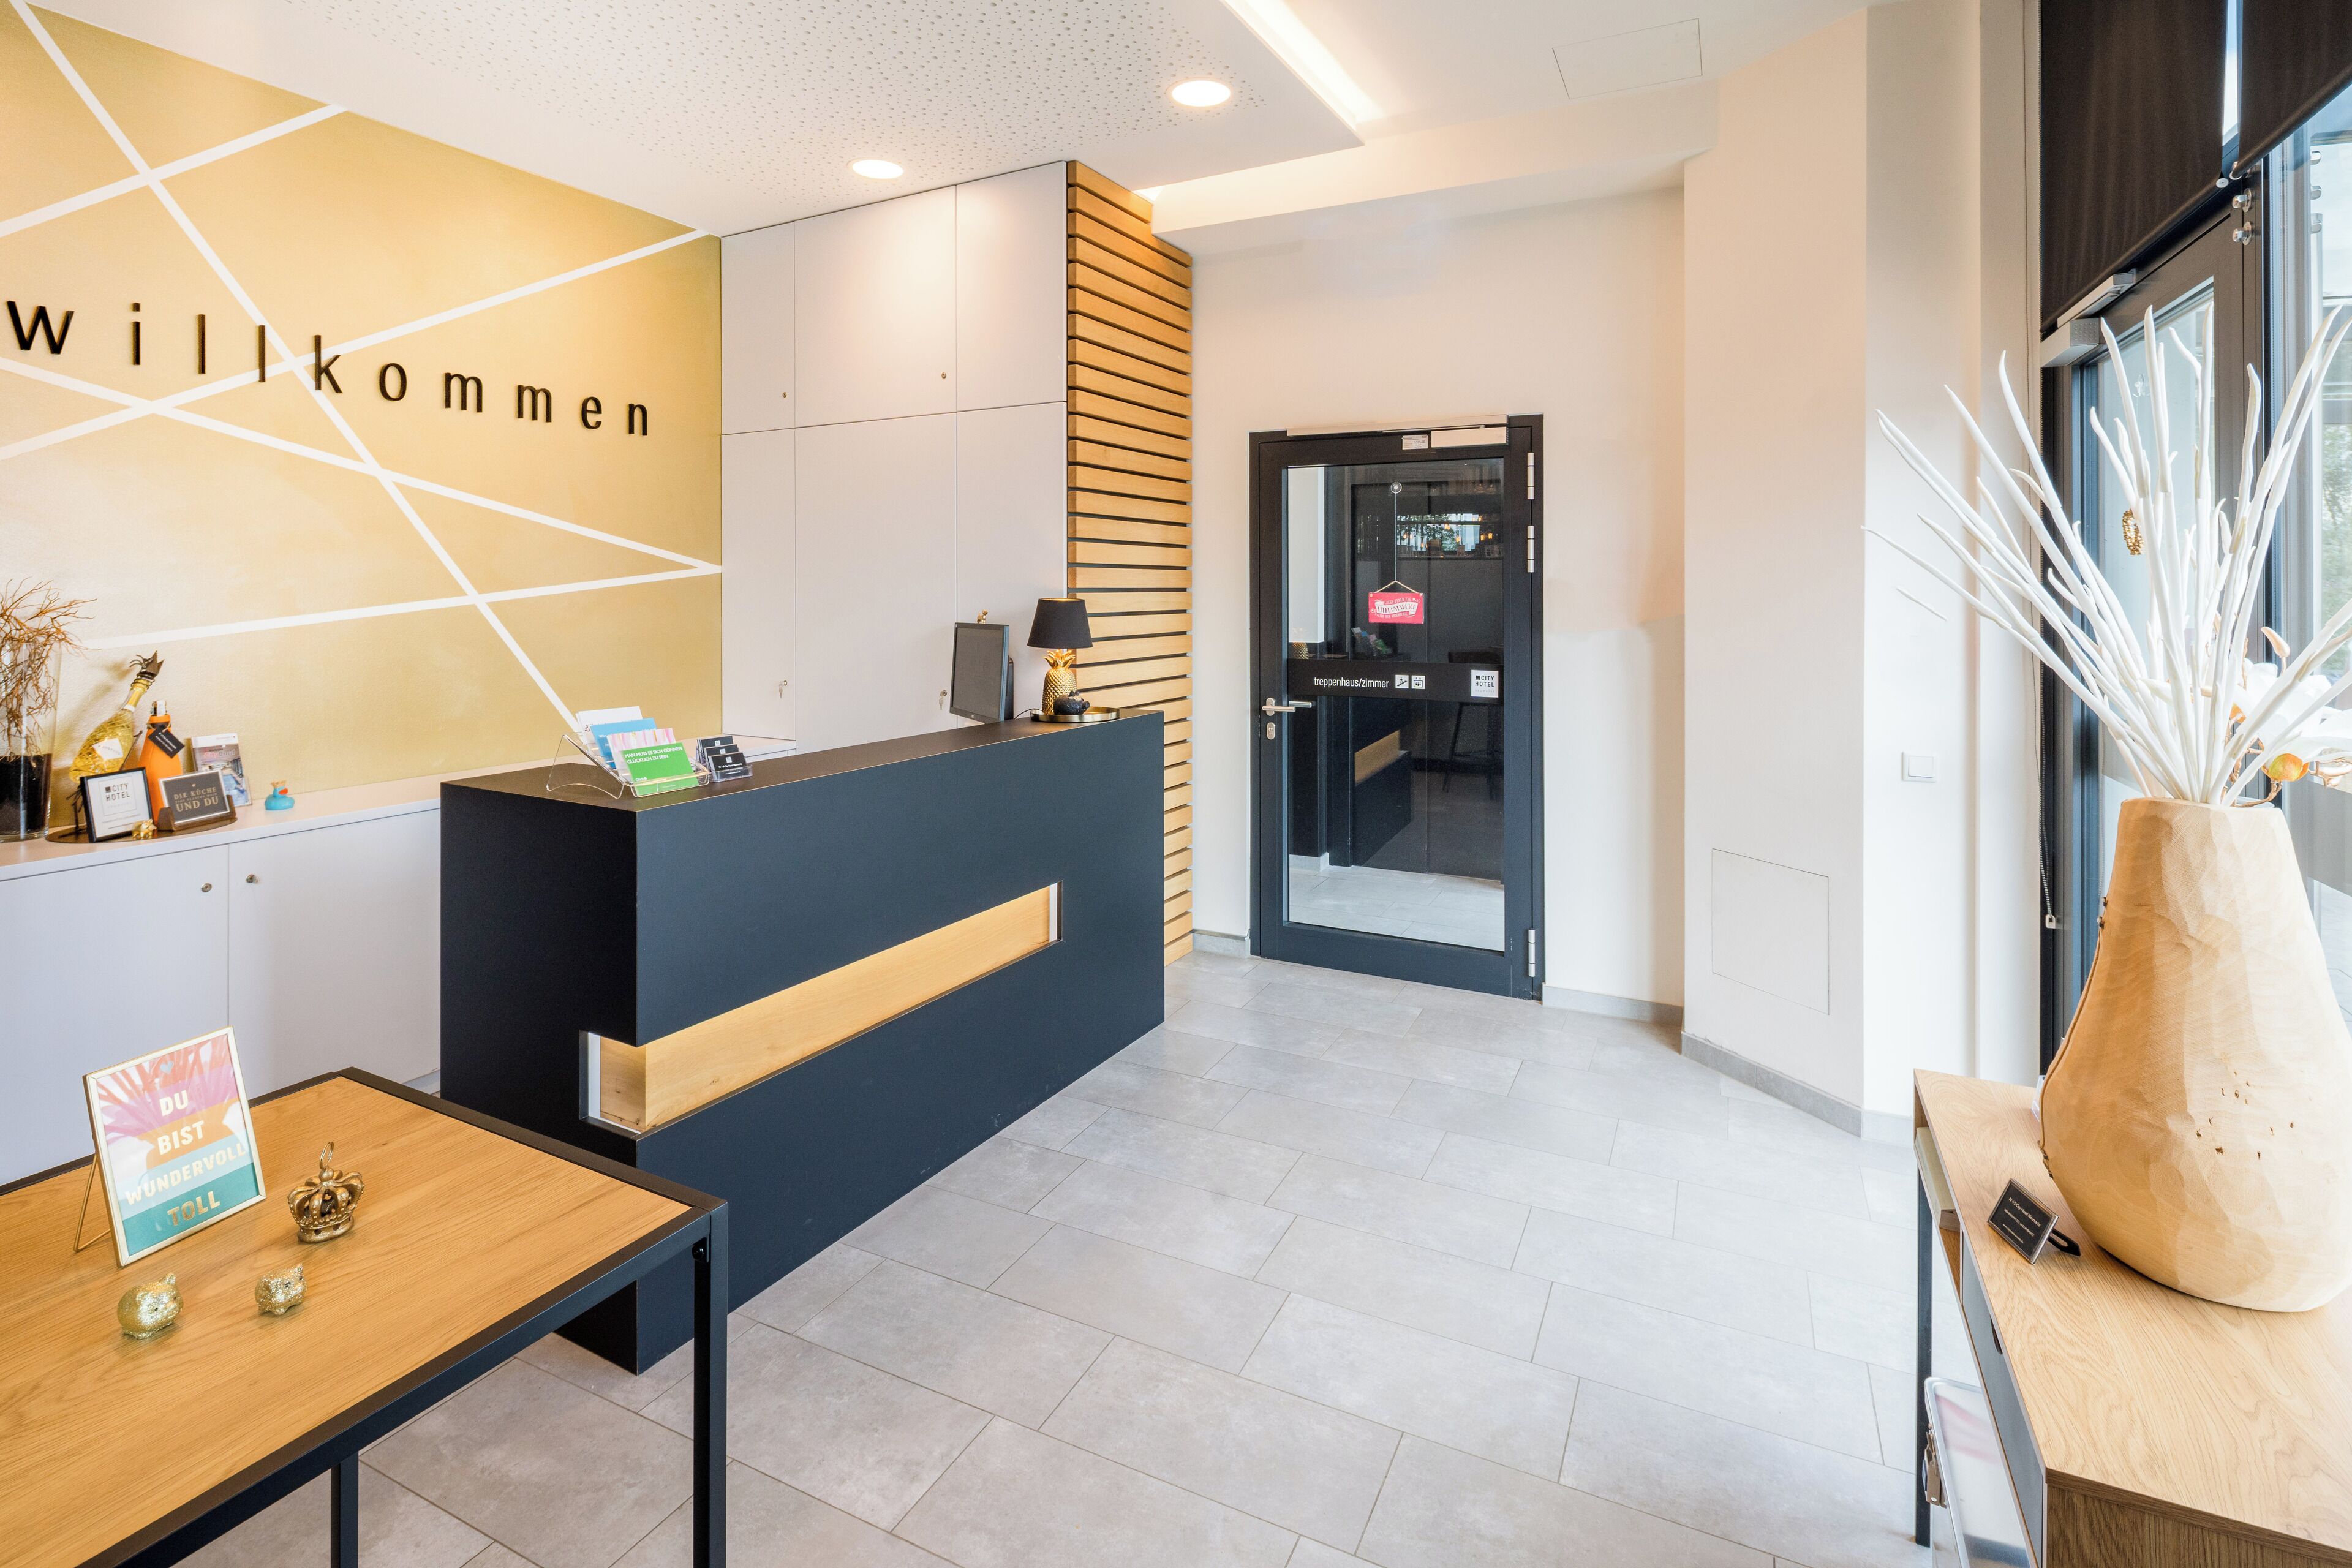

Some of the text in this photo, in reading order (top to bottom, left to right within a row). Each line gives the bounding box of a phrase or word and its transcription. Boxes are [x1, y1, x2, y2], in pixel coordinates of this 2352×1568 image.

[7, 300, 648, 436] willkommen
[1314, 677, 1389, 688] treppenhaus/zimmer
[105, 792, 130, 802] HOTEL
[112, 783, 129, 792] CITY
[190, 786, 217, 796] KÜCHE
[176, 796, 219, 812] UND DU
[159, 1090, 189, 1117] DU
[157, 1120, 205, 1155] BIST
[125, 1142, 246, 1206] WUNDERVOLL
[167, 1191, 221, 1226] TOLL
